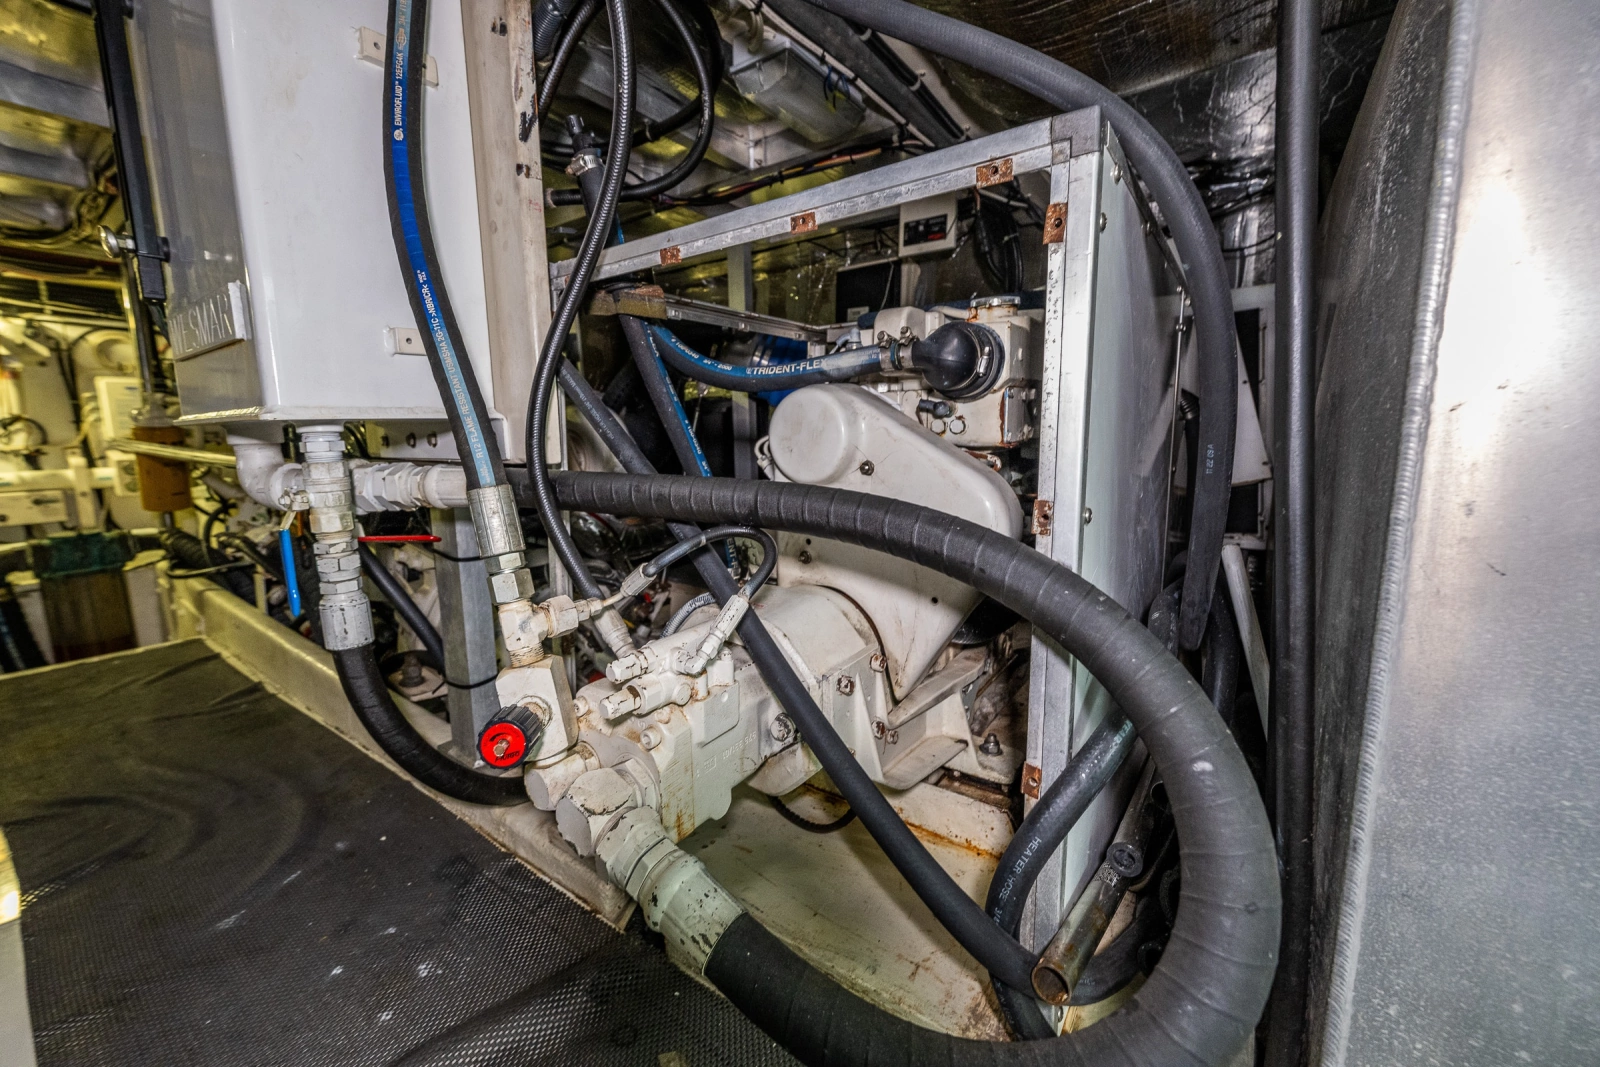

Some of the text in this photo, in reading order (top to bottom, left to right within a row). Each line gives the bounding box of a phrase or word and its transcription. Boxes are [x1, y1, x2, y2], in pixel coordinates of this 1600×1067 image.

[168, 294, 232, 355] WESMAR
[431, 318, 446, 341] 2G-11C
[440, 342, 456, 372] USMSHA
[450, 374, 469, 414] RESISTANT
[464, 415, 479, 442] FLAME
[474, 443, 483, 458] R12
[1013, 836, 1042, 874] HEATER
[999, 874, 1016, 902] HOSE
